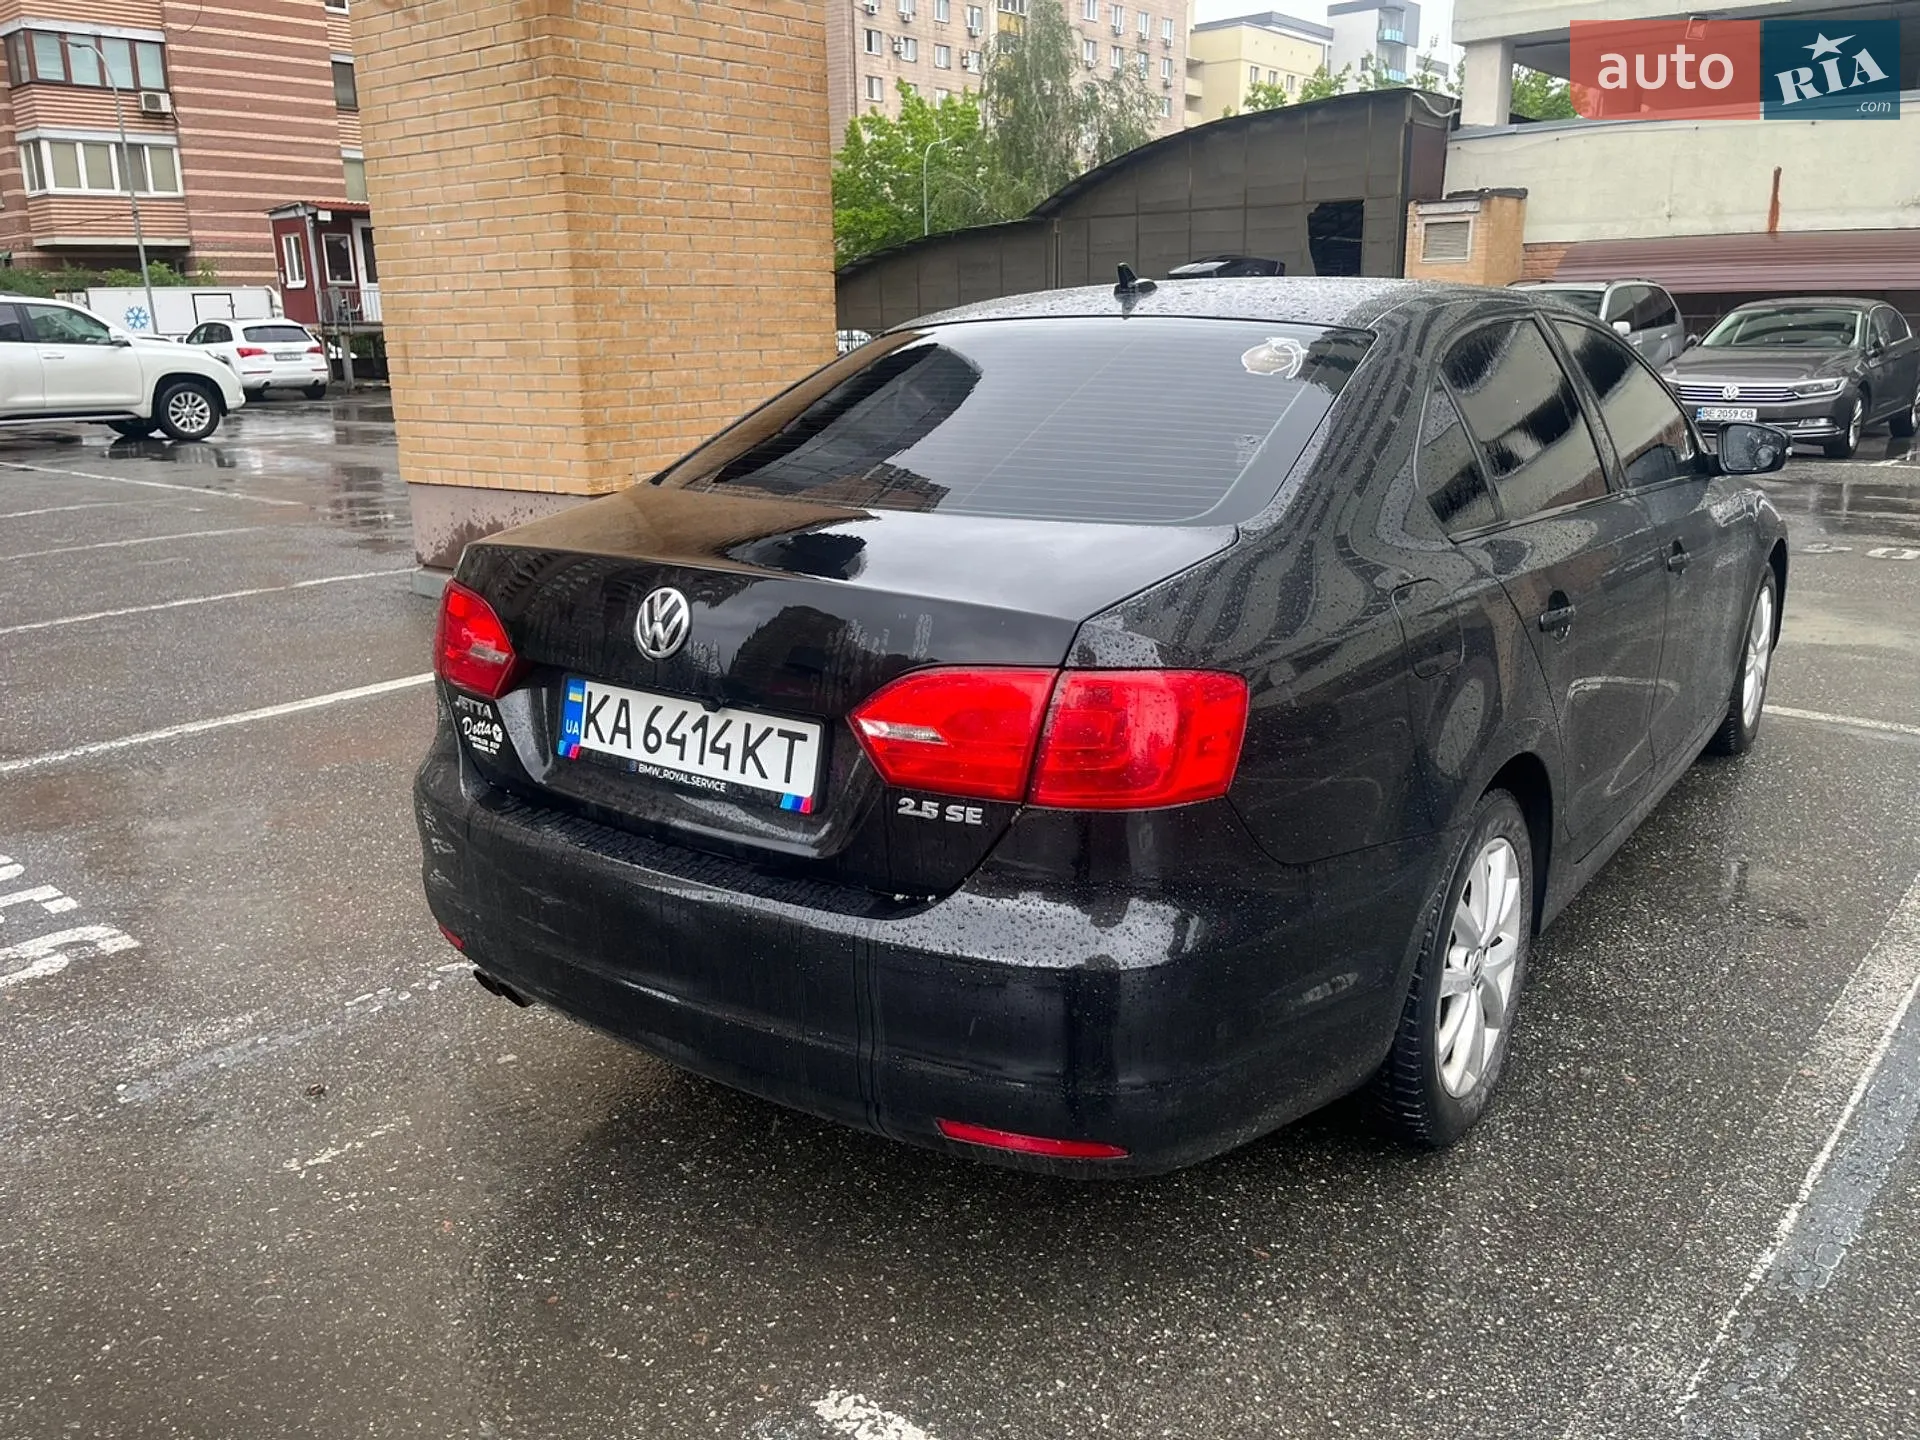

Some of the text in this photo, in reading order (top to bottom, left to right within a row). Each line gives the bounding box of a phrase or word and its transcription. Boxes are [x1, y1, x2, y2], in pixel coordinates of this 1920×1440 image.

[1717, 409, 1739, 418] 2059
[565, 719, 579, 735] UA
[583, 690, 808, 784] KA 6414 KT
[945, 804, 983, 825] SE
